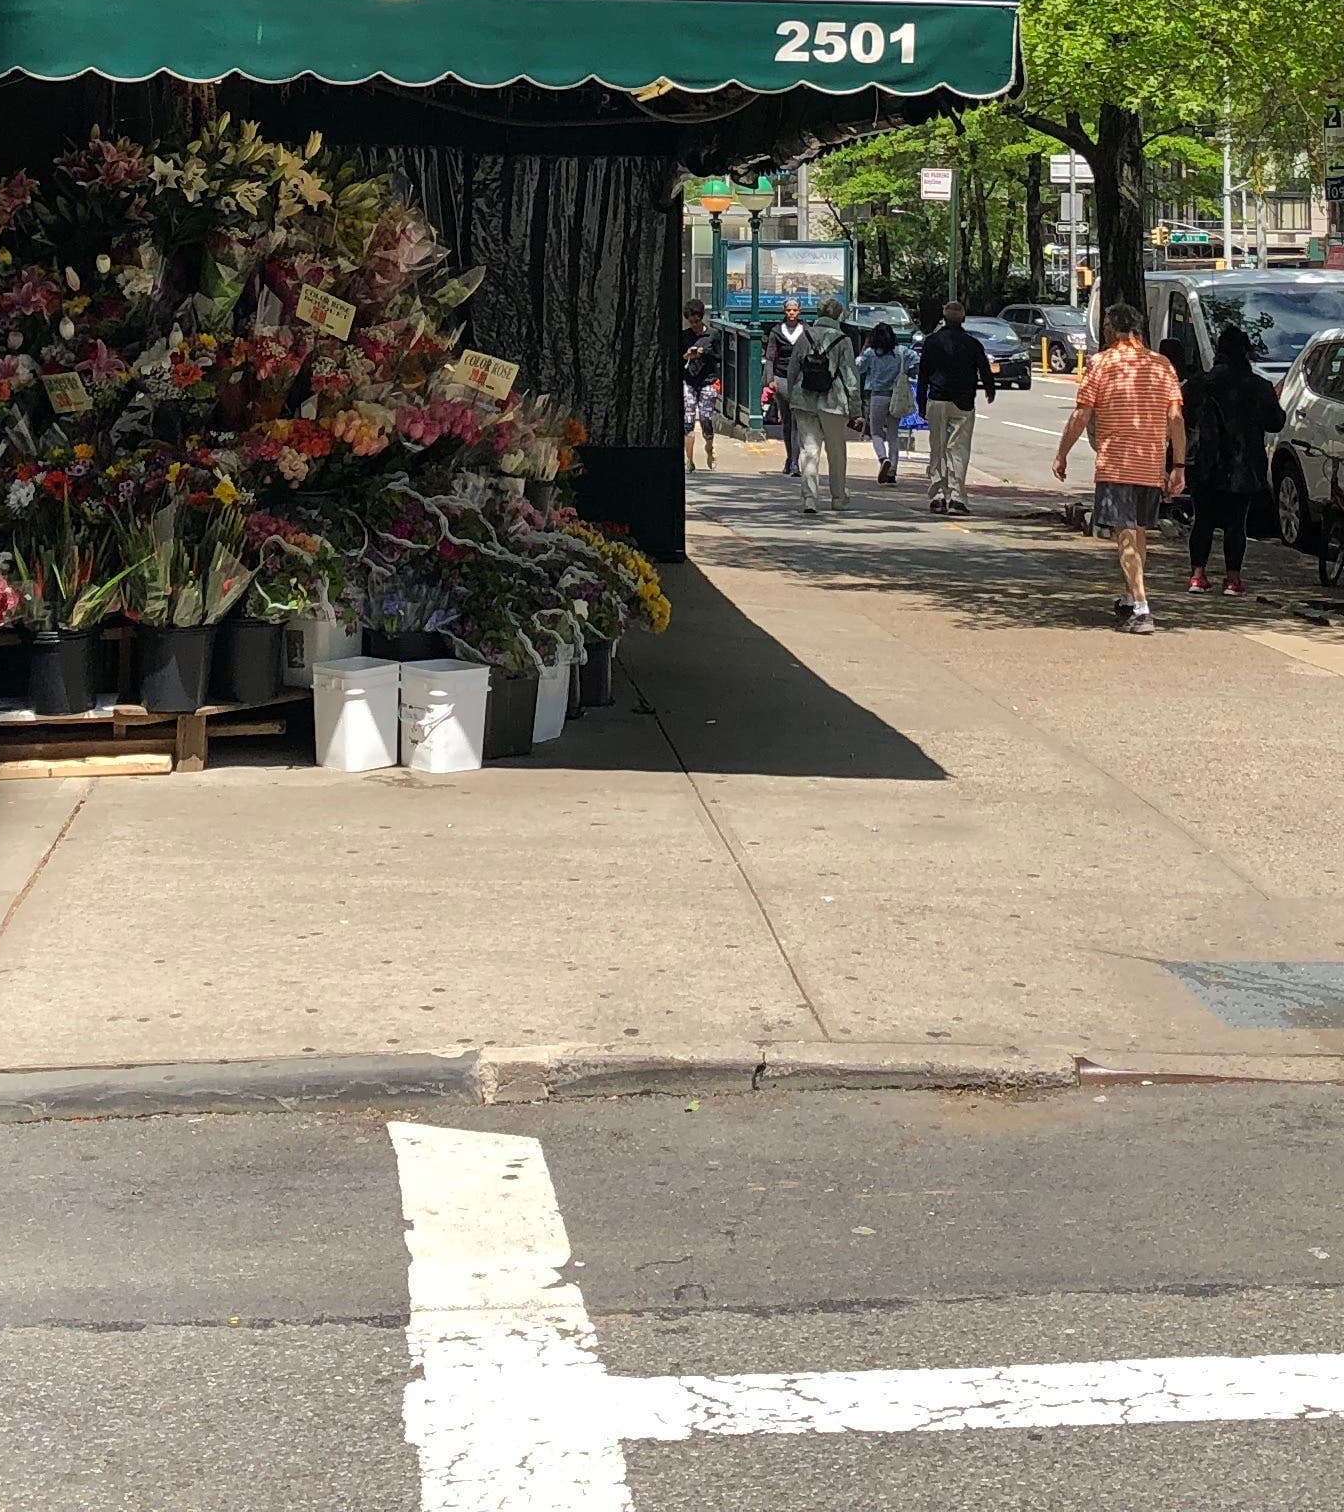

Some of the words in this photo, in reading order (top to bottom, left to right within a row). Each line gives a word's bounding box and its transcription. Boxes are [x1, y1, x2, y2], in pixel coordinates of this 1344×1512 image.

[774, 20, 916, 64] 2501
[463, 353, 493, 373] COLOR
[492, 362, 515, 380] ROSE
